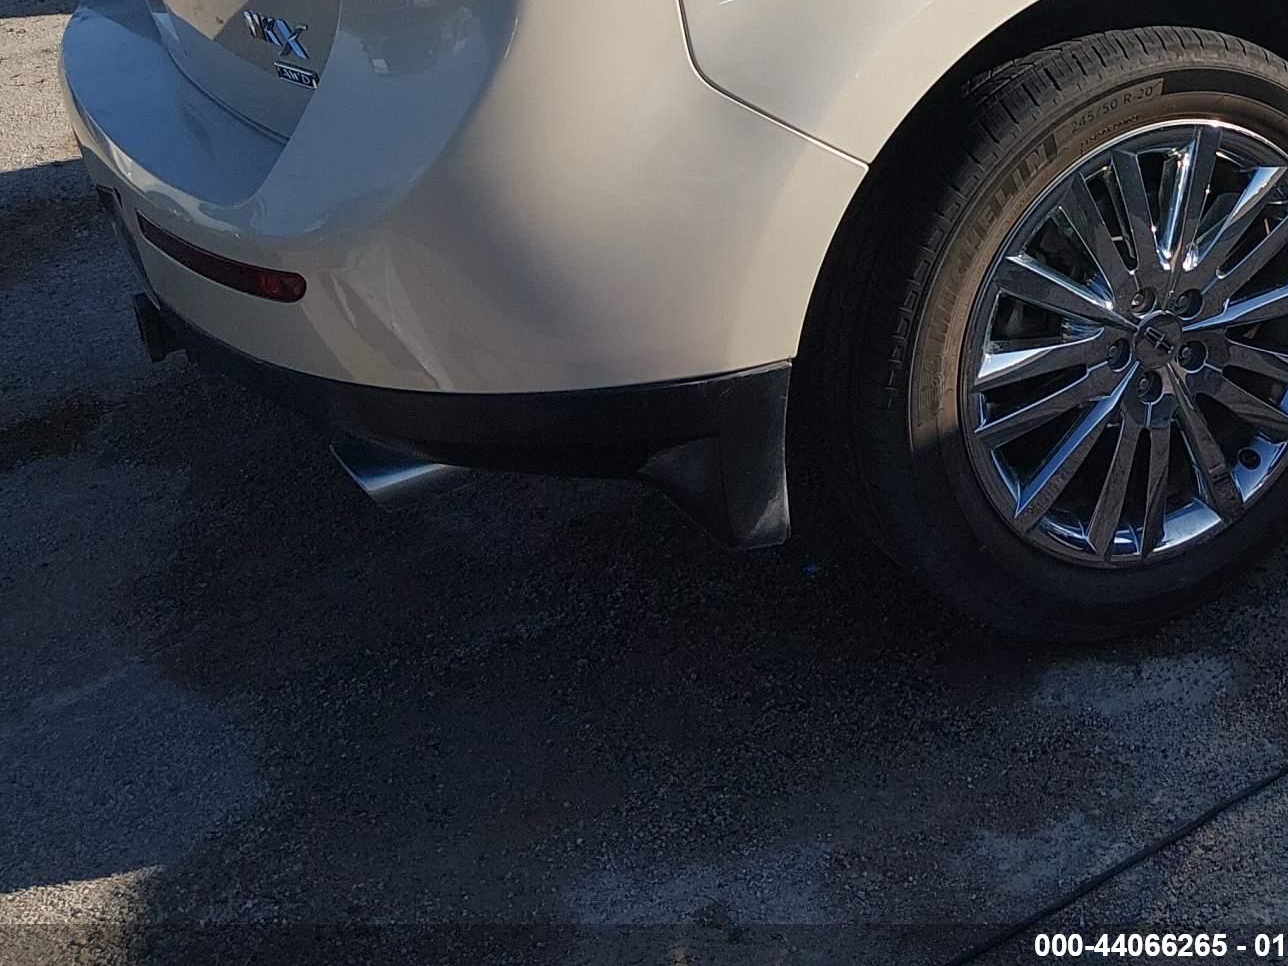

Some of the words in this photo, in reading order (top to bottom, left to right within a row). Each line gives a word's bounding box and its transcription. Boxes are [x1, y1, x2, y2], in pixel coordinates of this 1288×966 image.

[282, 68, 311, 85] AWD
[1071, 98, 1118, 133] 245/50
[1123, 93, 1132, 104] R
[1137, 86, 1153, 100] 20
[929, 142, 1049, 344] MICHELIN
